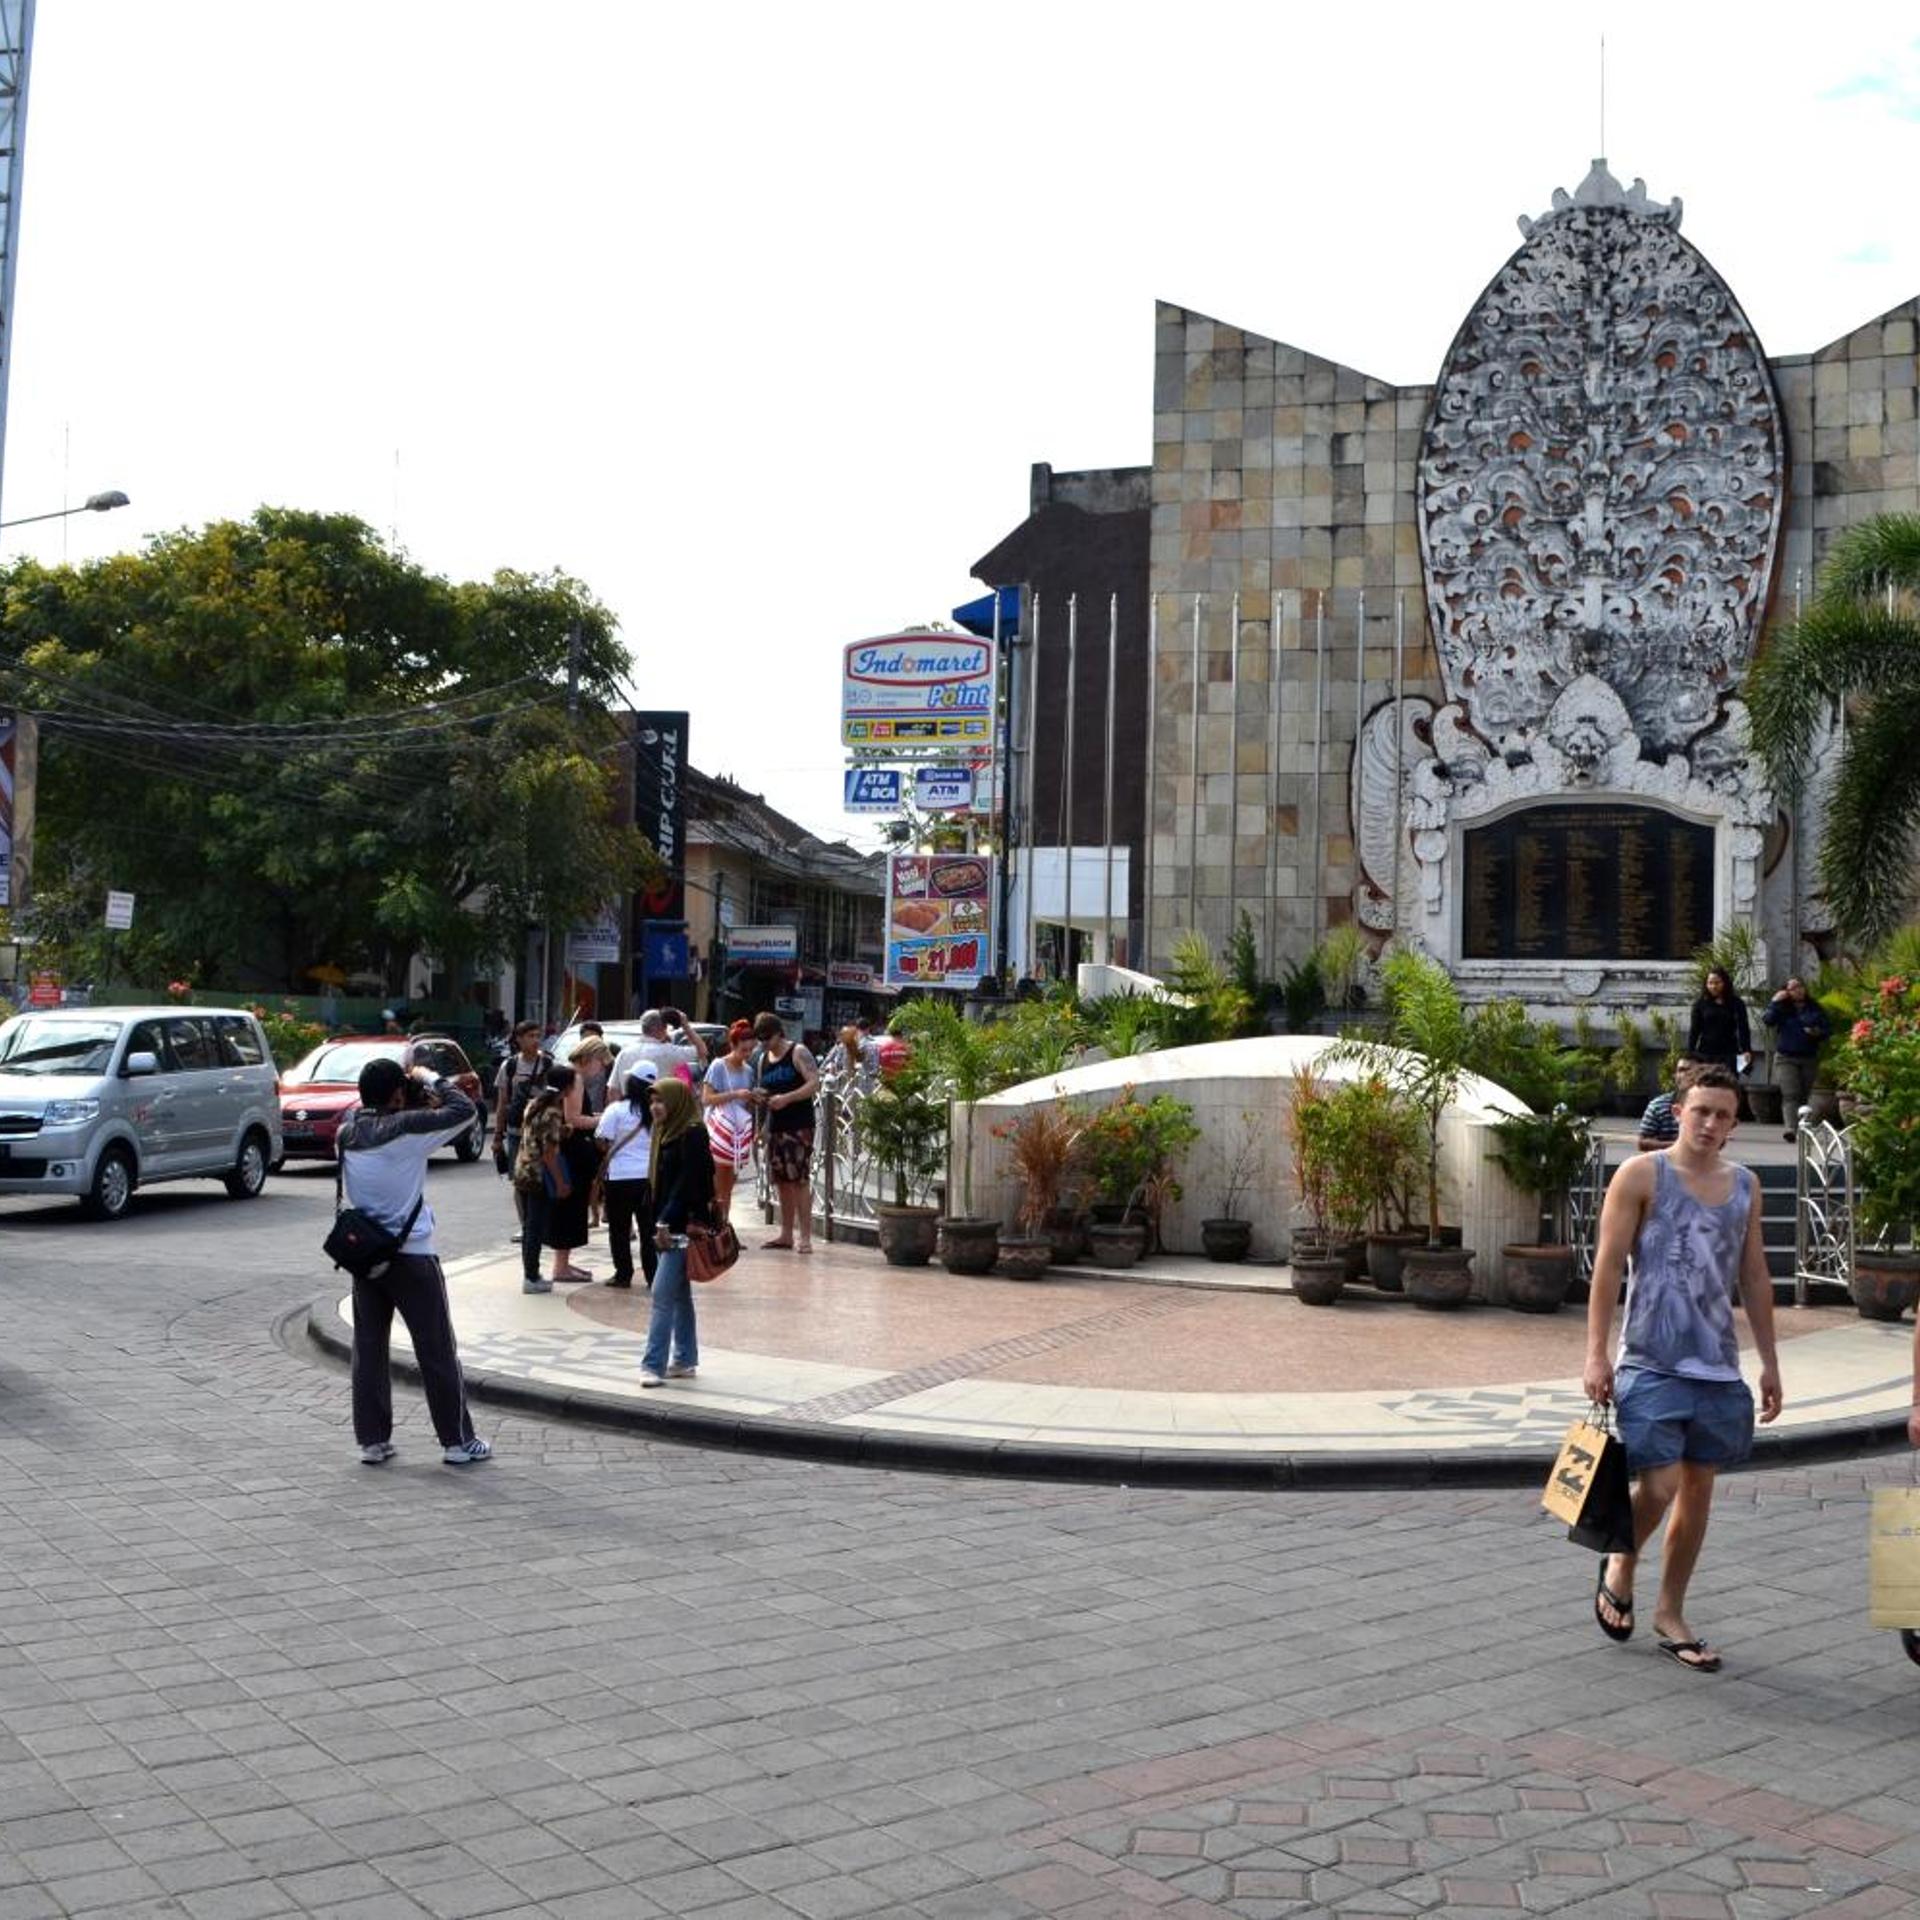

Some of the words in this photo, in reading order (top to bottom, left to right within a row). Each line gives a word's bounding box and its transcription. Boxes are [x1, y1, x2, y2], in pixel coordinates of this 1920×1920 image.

[854, 650, 982, 674] Indomaret
[928, 683, 990, 708] Point
[659, 728, 678, 809] CURL
[863, 773, 890, 785] ATM
[928, 785, 960, 796] ATM
